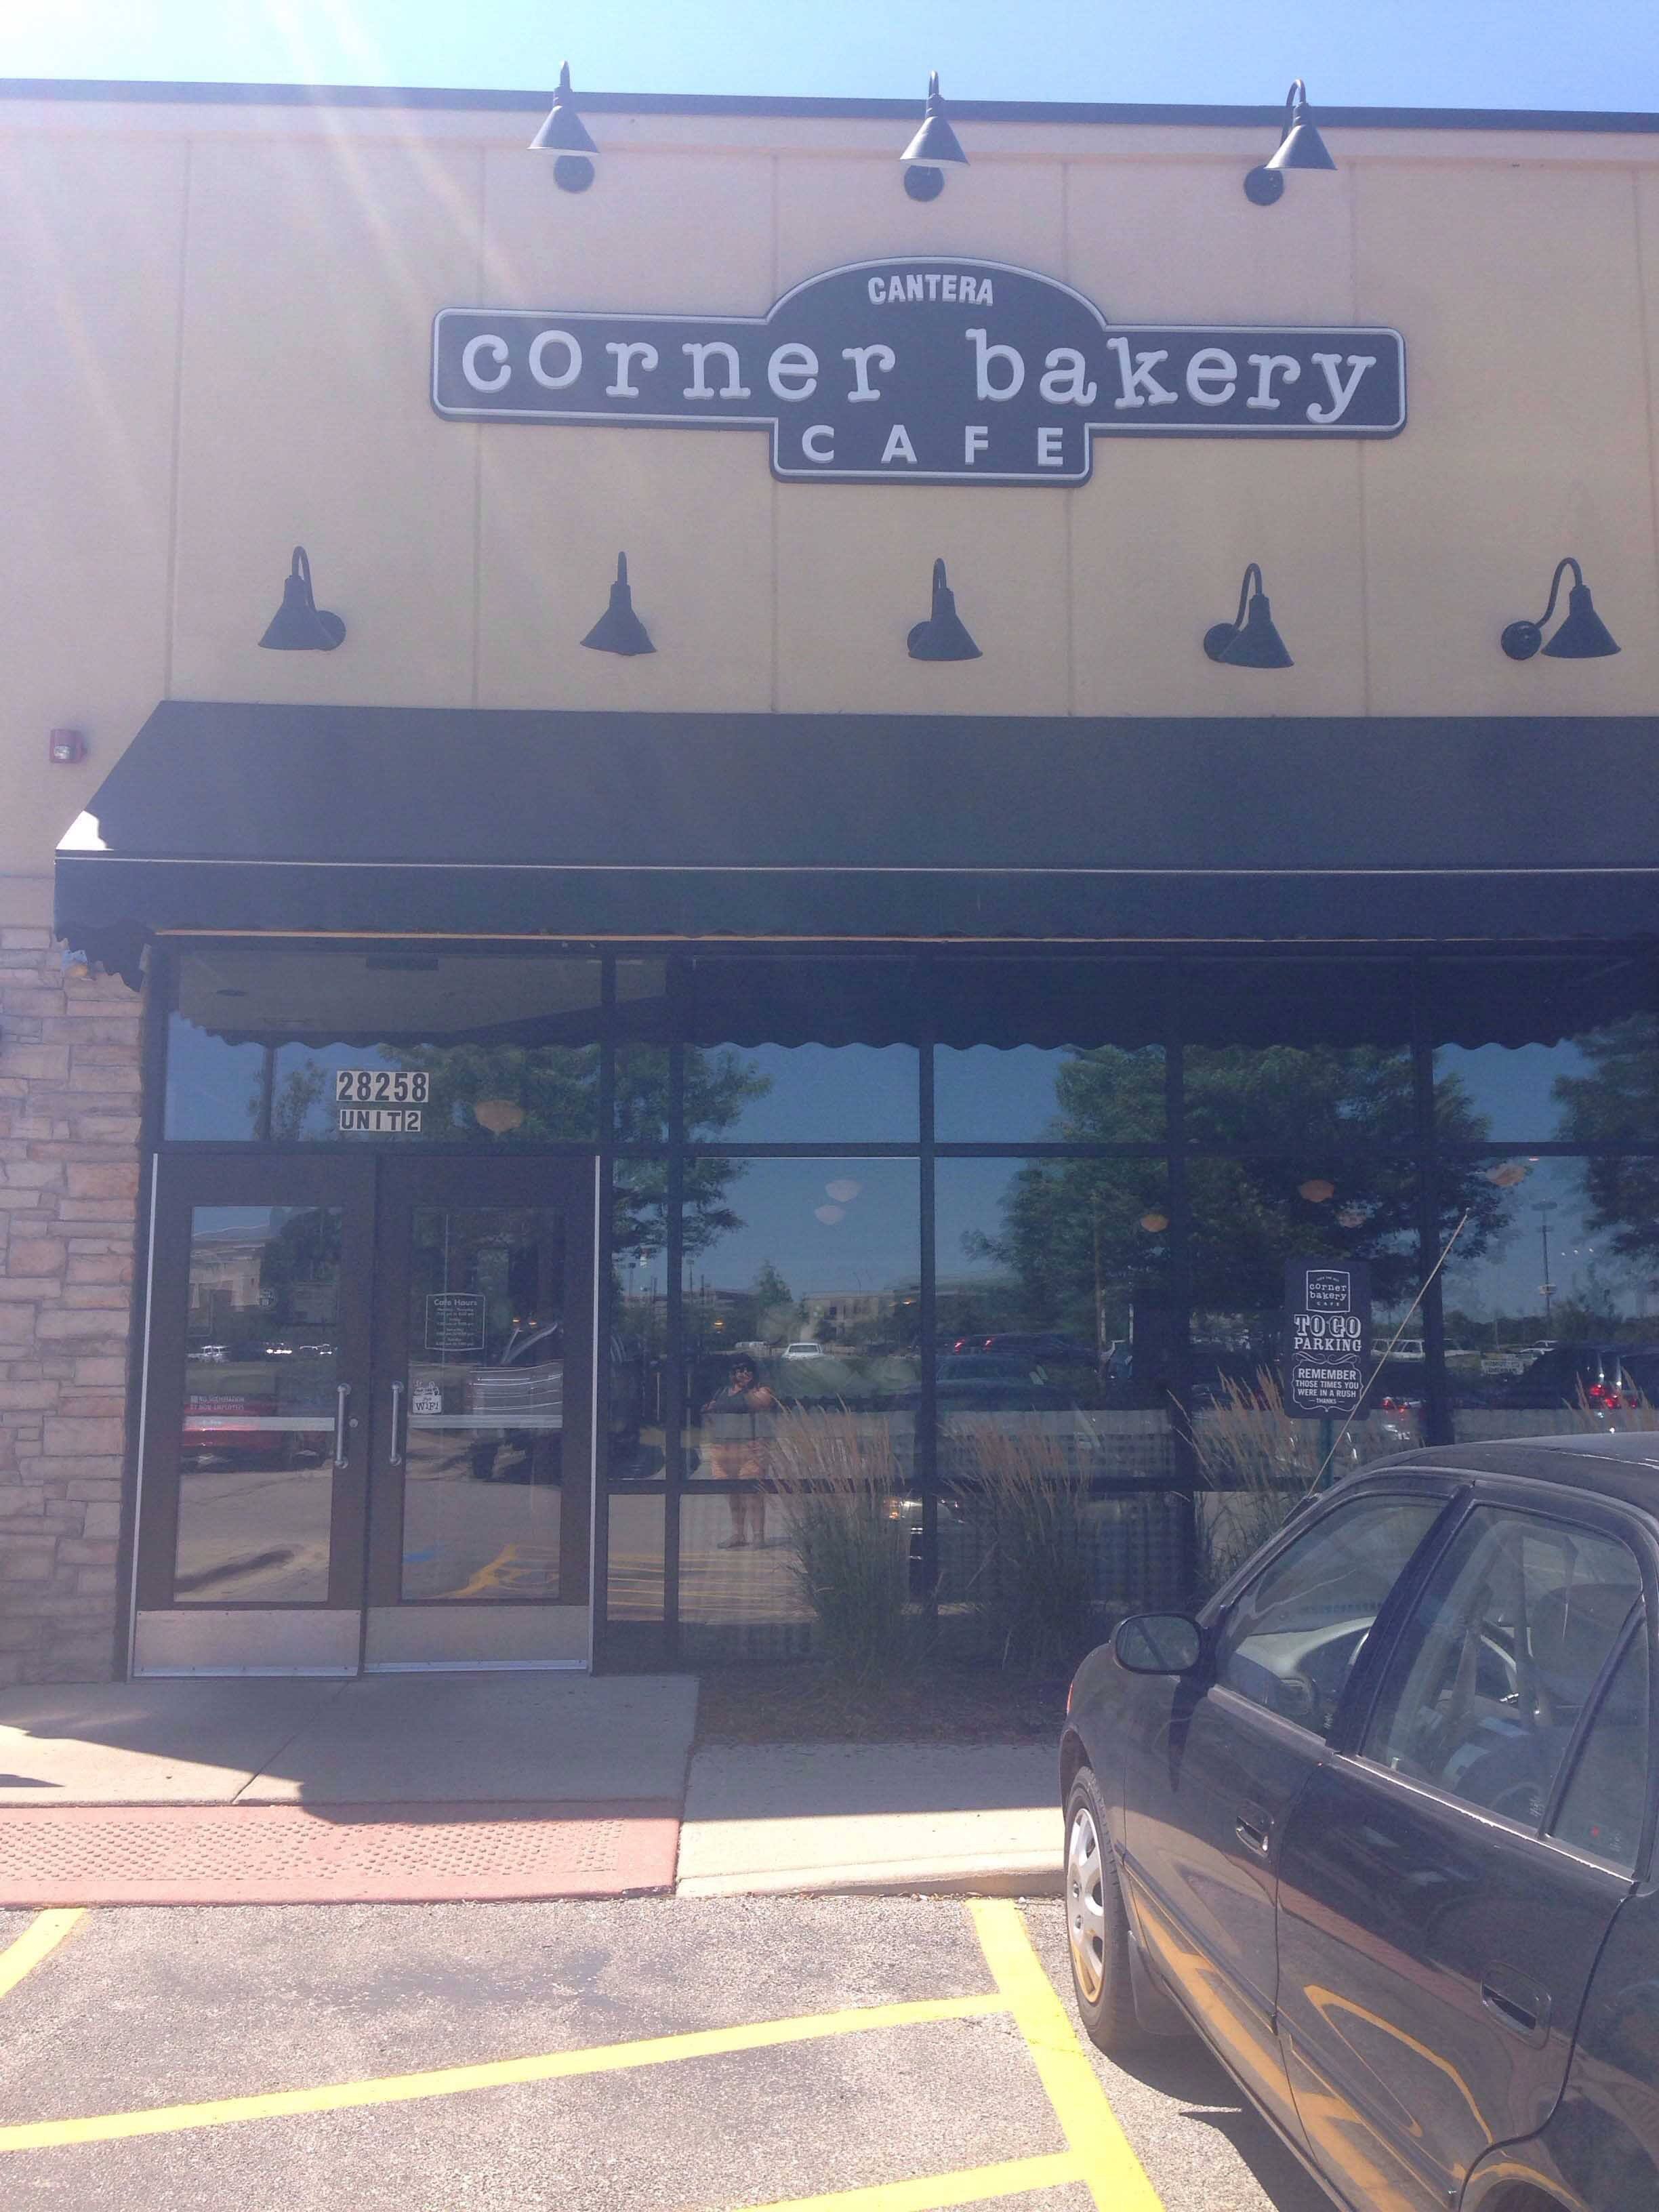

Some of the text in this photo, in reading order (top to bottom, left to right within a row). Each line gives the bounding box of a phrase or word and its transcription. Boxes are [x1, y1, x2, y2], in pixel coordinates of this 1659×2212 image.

[867, 274, 994, 306] CANTERA
[462, 328, 1377, 424] corner bakery
[801, 424, 1065, 466] CAFE
[338, 1071, 426, 1102] 28258
[341, 1110, 419, 1131] UNIT 2
[1309, 1283, 1347, 1292] corner
[1309, 1290, 1347, 1301] bakery
[1294, 1337, 1362, 1351] PARKING
[1298, 1368, 1356, 1380] REMEMBER
[1295, 1379, 1318, 1388] THOSE
[1320, 1380, 1343, 1389] TIMES
[1297, 1388, 1318, 1396] WERE
